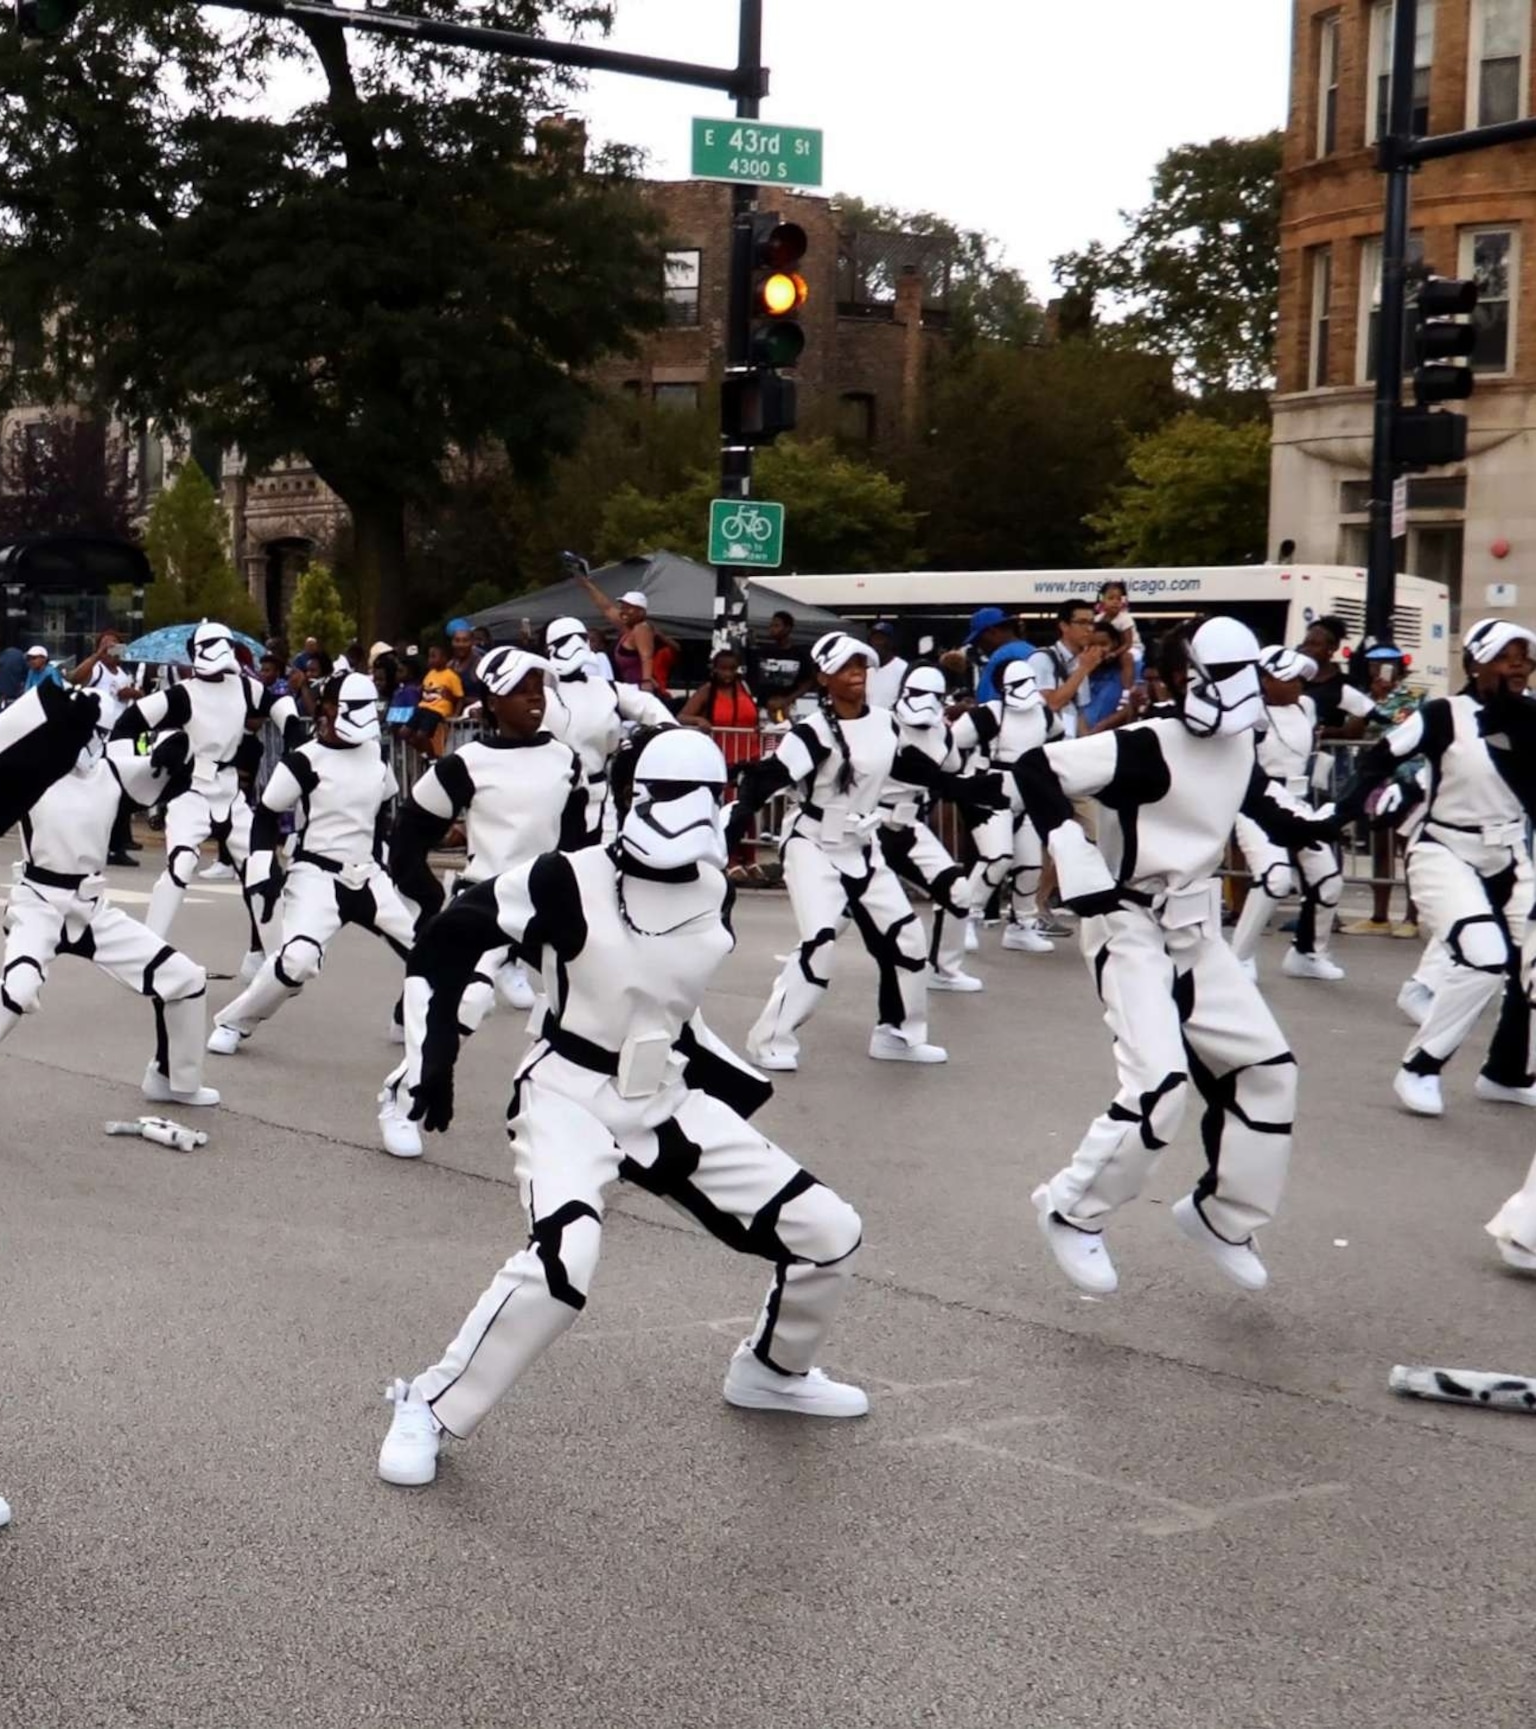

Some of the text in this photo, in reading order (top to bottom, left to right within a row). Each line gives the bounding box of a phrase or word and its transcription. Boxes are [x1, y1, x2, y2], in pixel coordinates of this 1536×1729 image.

[704, 127, 810, 156] E 43rd St
[728, 157, 788, 179] 4300 S
[1034, 577, 1201, 595] www.transicago.com
